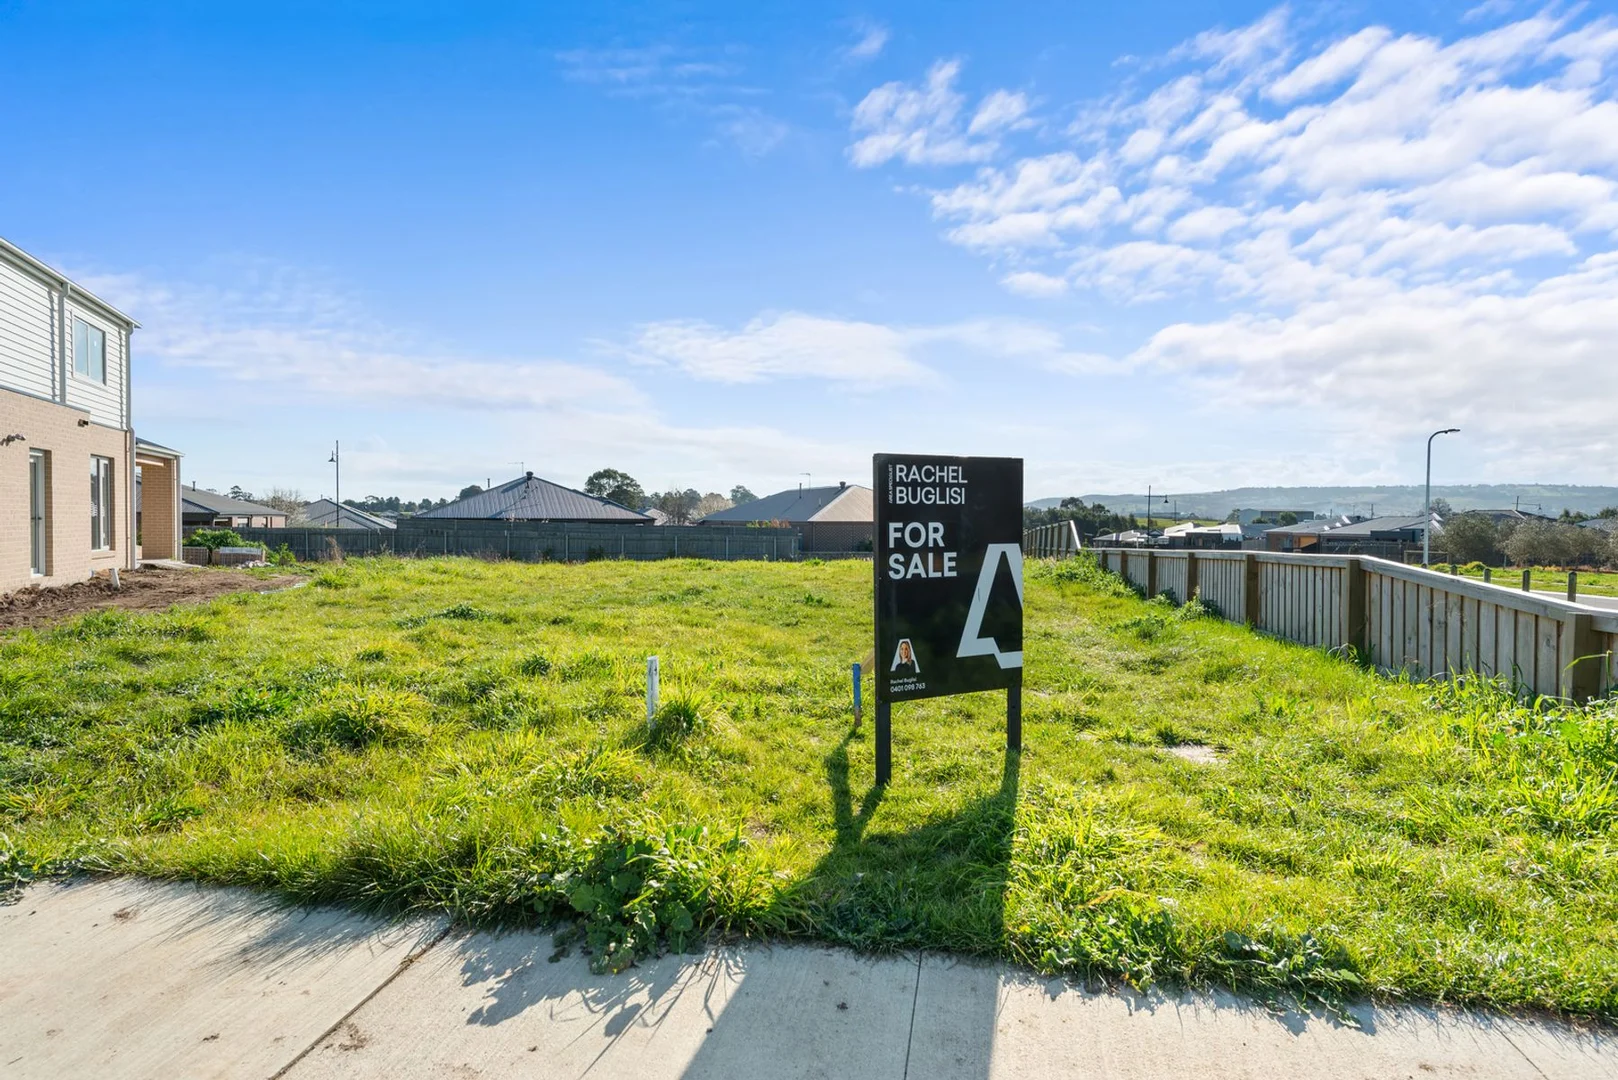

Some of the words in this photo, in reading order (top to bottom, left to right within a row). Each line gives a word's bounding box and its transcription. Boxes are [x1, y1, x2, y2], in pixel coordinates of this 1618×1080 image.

[895, 464, 968, 484] RACHEL
[896, 486, 965, 505] BUGLISI
[888, 521, 945, 549] FOR
[888, 551, 958, 580] SALE
